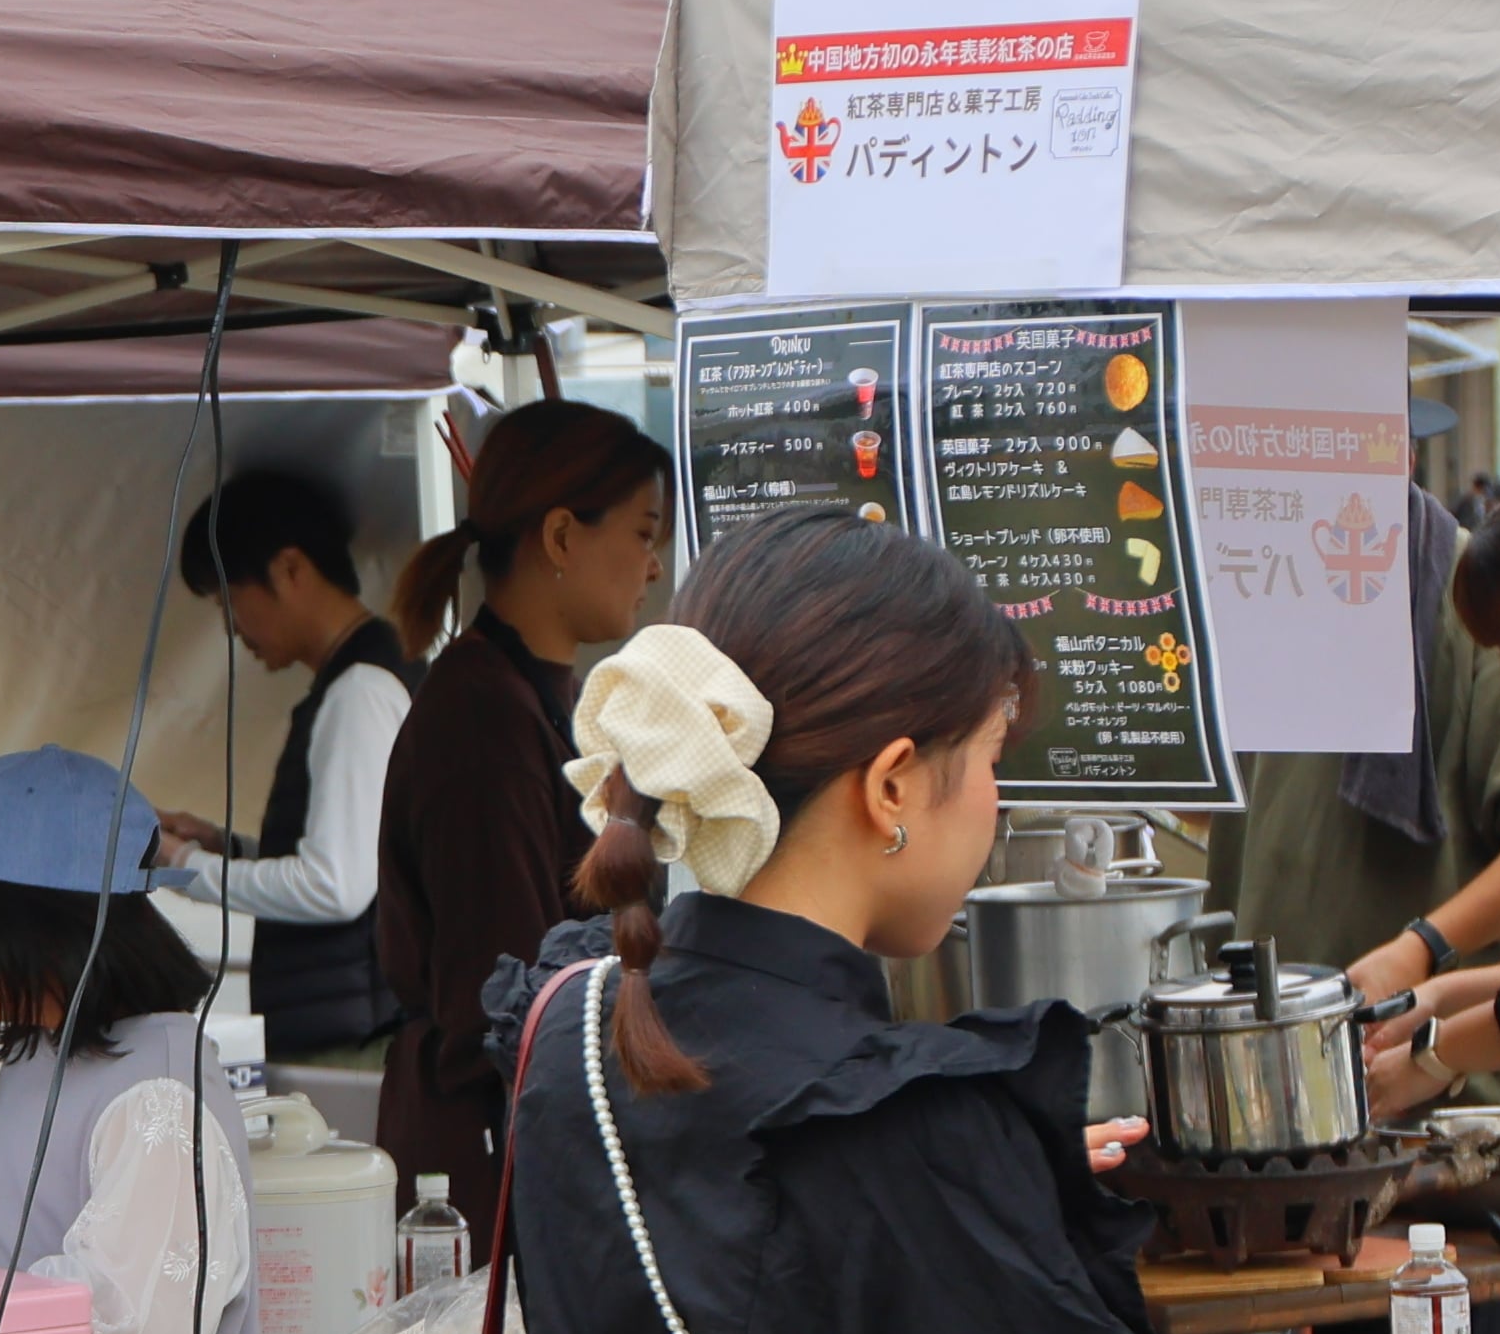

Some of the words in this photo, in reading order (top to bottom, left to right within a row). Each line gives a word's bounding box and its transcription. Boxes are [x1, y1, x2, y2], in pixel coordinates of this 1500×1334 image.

[807, 32, 1075, 74] 中国地方初の永年表彰紅茶の店
[845, 132, 1039, 179] パディントン
[1015, 329, 1076, 351] 英国菓子
[939, 359, 1063, 380] 紅茶専門店のスコーン
[943, 384, 984, 400] プレーン
[1035, 381, 1077, 397] 720円
[727, 402, 774, 418] ホット紅茶
[783, 399, 820, 413] 400円
[1036, 400, 1077, 415] 760円
[720, 442, 775, 457] アイスティー
[783, 437, 824, 452] 500円
[942, 436, 992, 455] 英国菓子
[1055, 434, 1103, 452] 900円
[944, 460, 1045, 477] ヴィクトリアケーキ
[1057, 459, 1070, 475] &
[947, 481, 1089, 502] 広島レモンドリズルケーキ
[966, 554, 1009, 569] プレーン
[1055, 634, 1147, 653] 福山ボタニカル
[1059, 658, 1135, 677] 米粉クッキー
[1117, 679, 1164, 694] 1080円
[1083, 764, 1137, 777] パディントン
